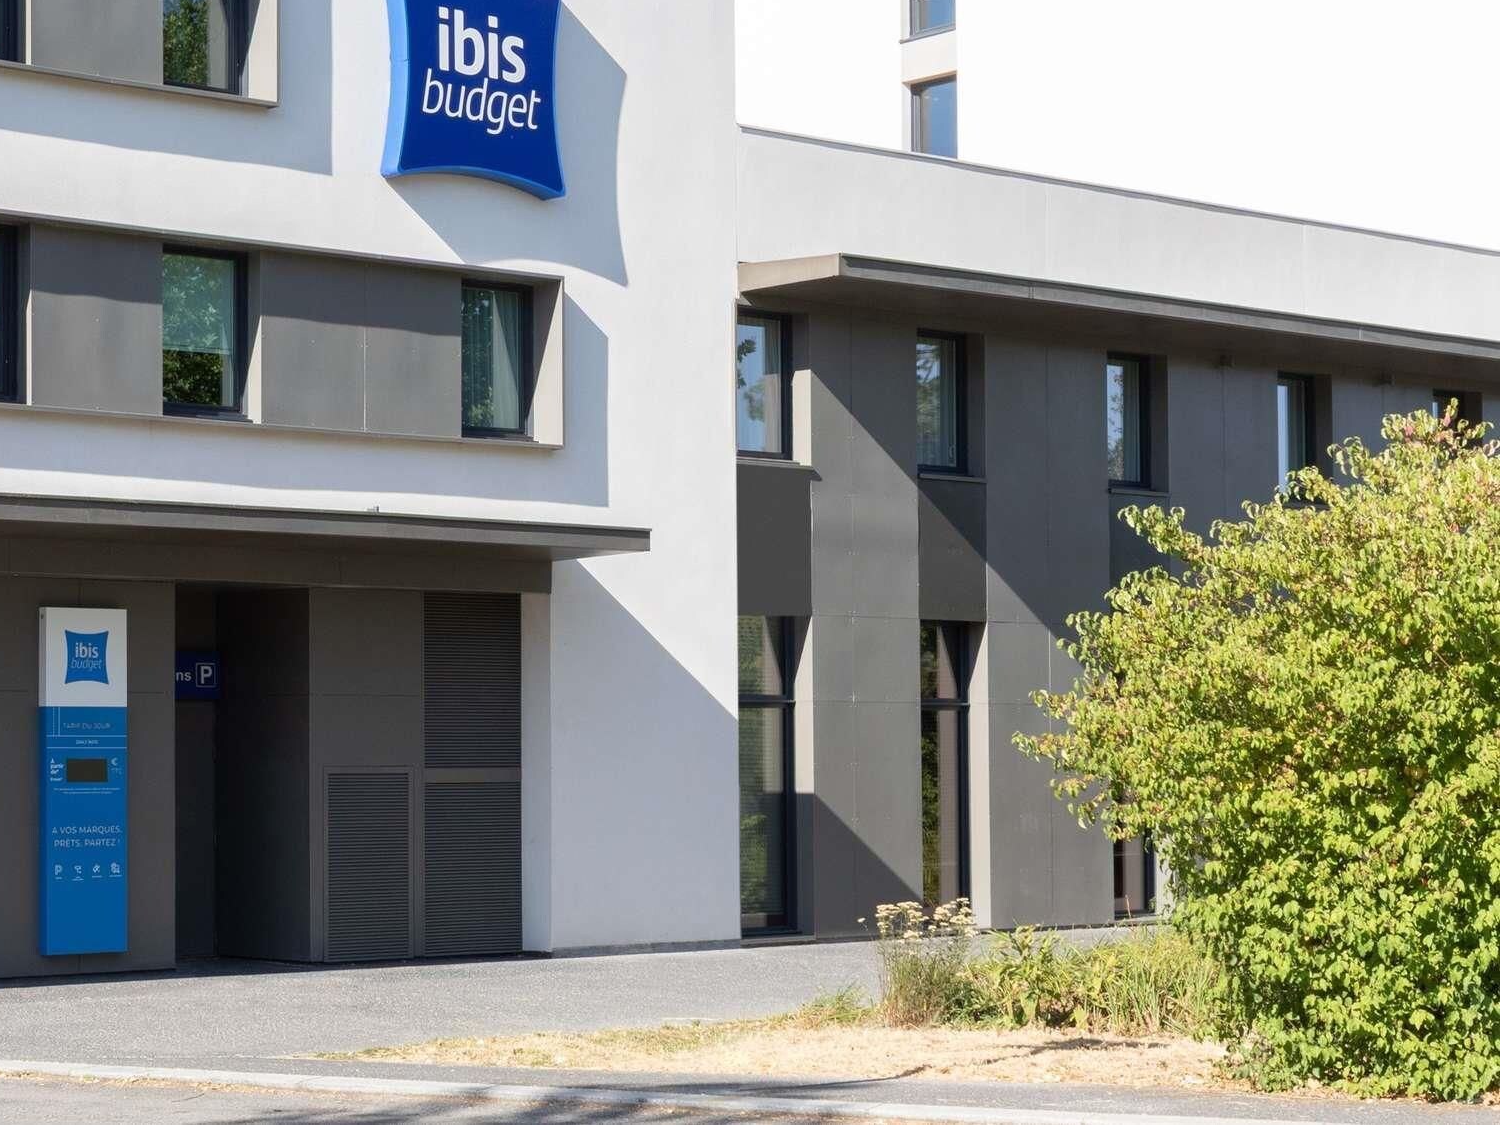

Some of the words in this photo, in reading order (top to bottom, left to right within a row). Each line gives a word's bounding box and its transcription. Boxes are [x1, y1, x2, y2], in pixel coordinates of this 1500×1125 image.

[438, 6, 526, 83] ibis
[422, 68, 542, 135] budget
[75, 642, 99, 658] ibis
[71, 657, 102, 672] budget
[200, 665, 213, 684] P
[84, 838, 116, 847] PARTEZ
